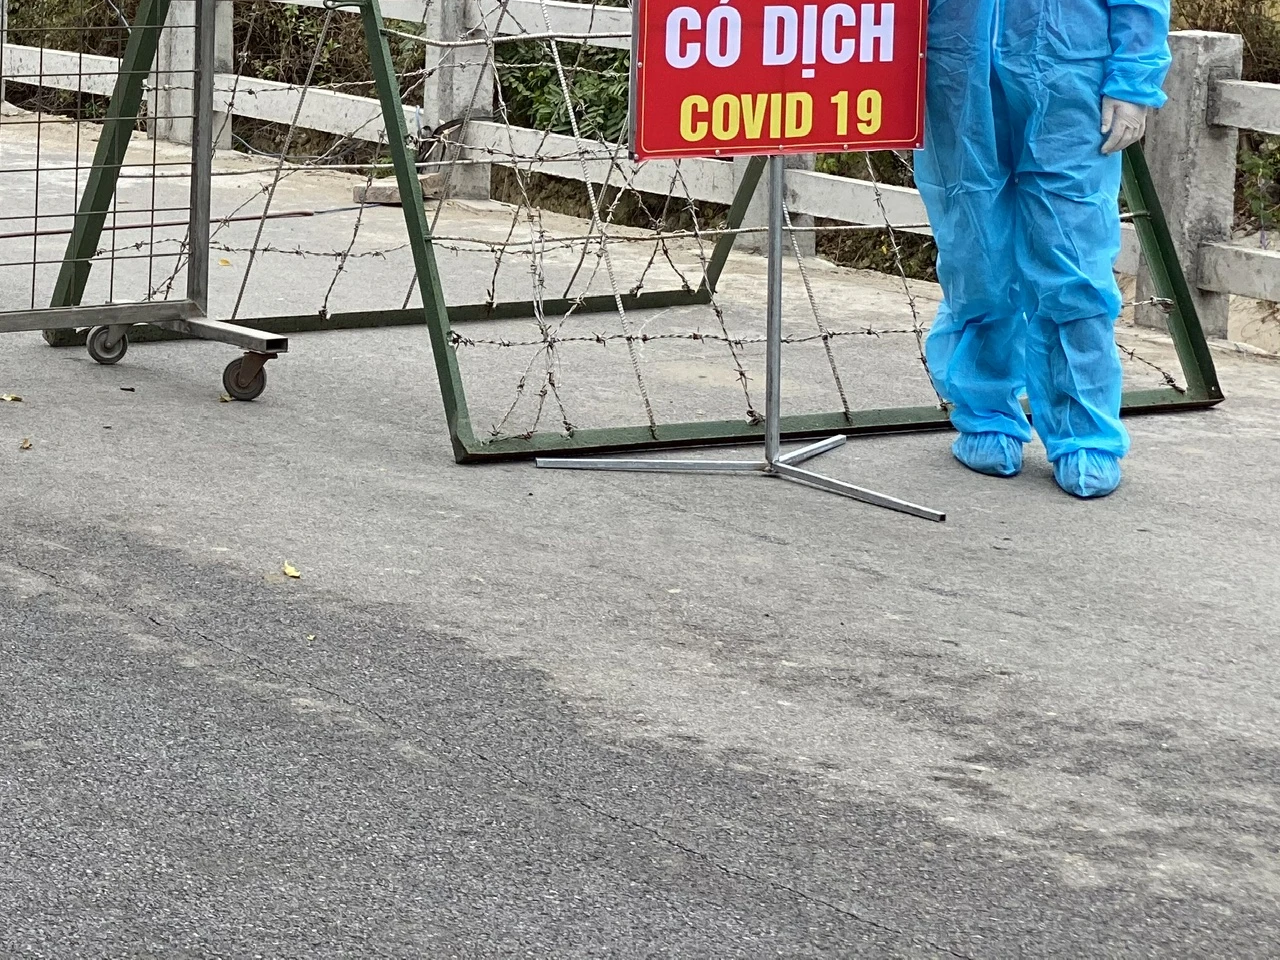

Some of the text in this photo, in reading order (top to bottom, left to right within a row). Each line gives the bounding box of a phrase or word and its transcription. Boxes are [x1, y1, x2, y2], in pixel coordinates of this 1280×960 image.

[762, 2, 895, 79] DỊCH
[679, 89, 883, 142] COVID 19
